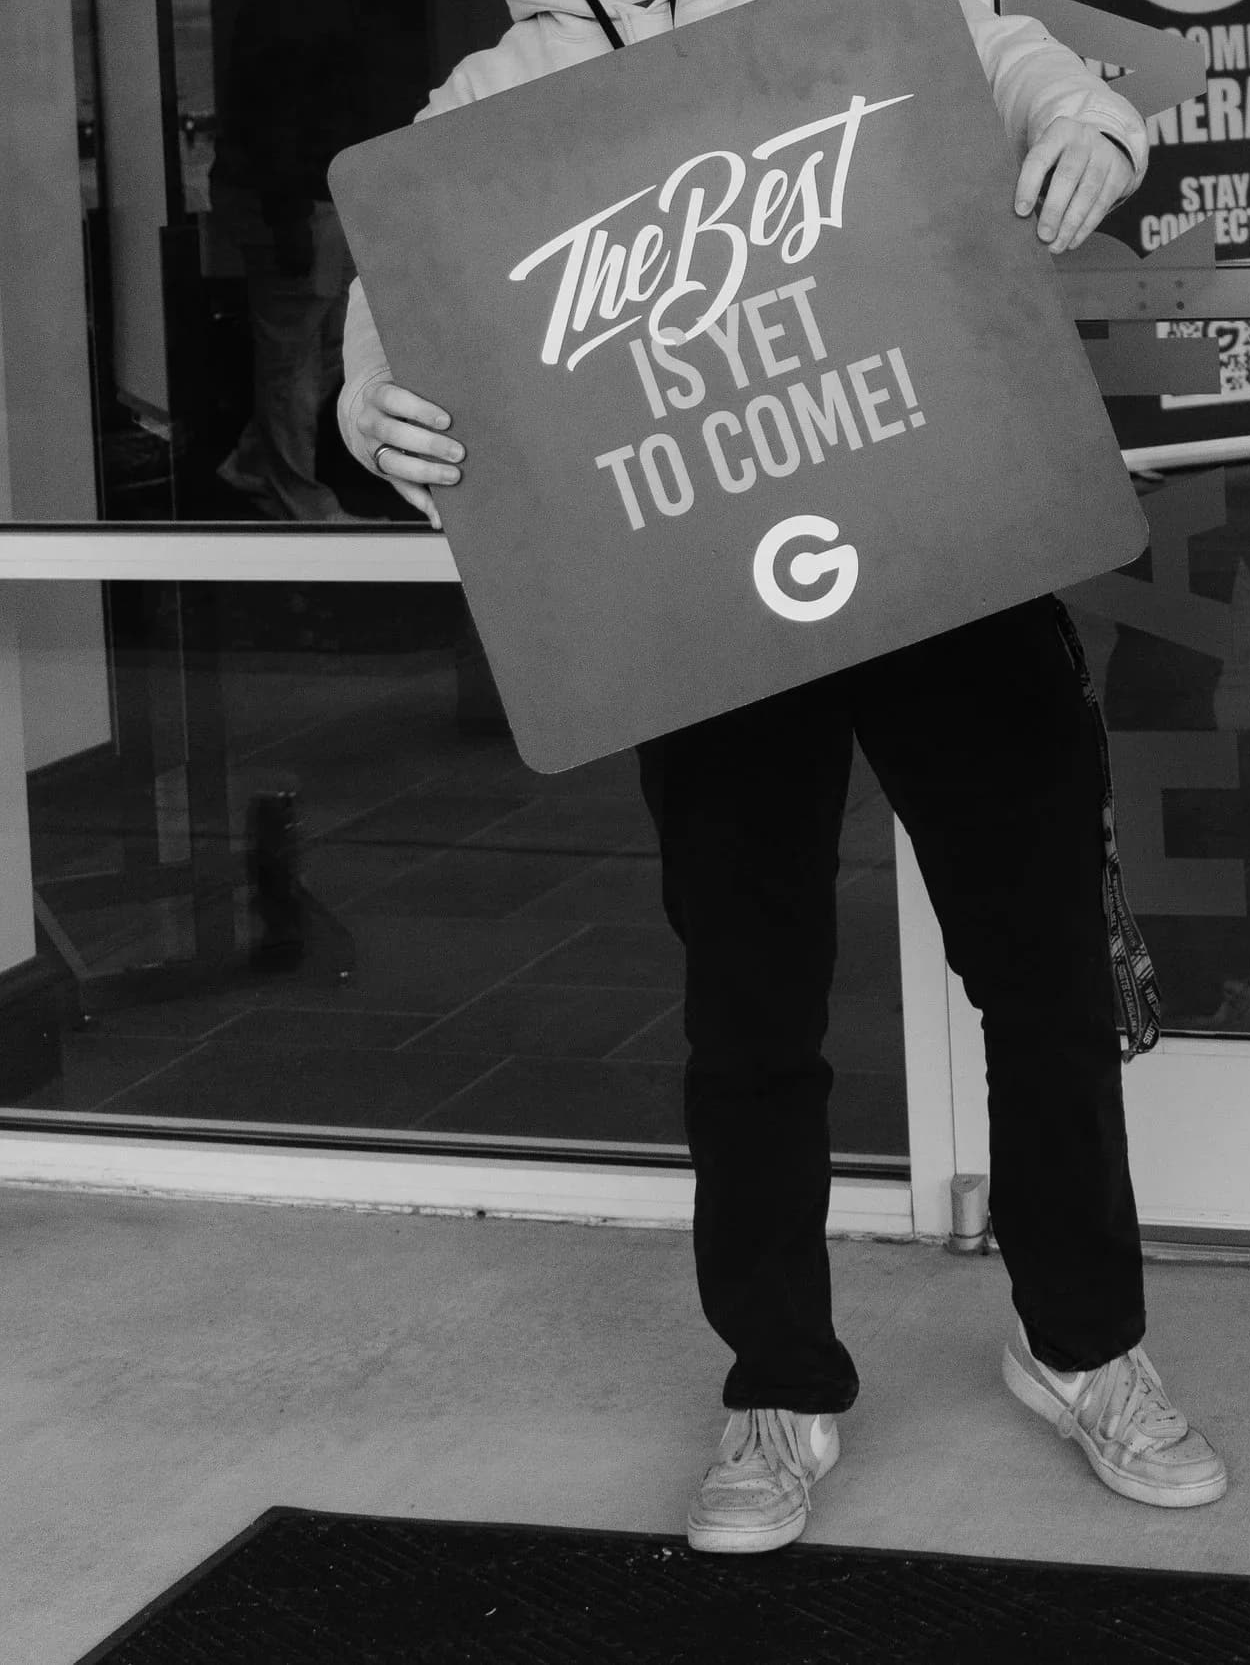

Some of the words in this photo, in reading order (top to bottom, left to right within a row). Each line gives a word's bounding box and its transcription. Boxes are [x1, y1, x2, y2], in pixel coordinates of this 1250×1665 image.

[508, 184, 671, 372] The
[648, 93, 915, 346] Best
[1180, 171, 1250, 212] STAY
[628, 325, 706, 419] IS
[696, 275, 829, 389] YET
[594, 433, 695, 531] TO
[701, 346, 927, 495] COME!
